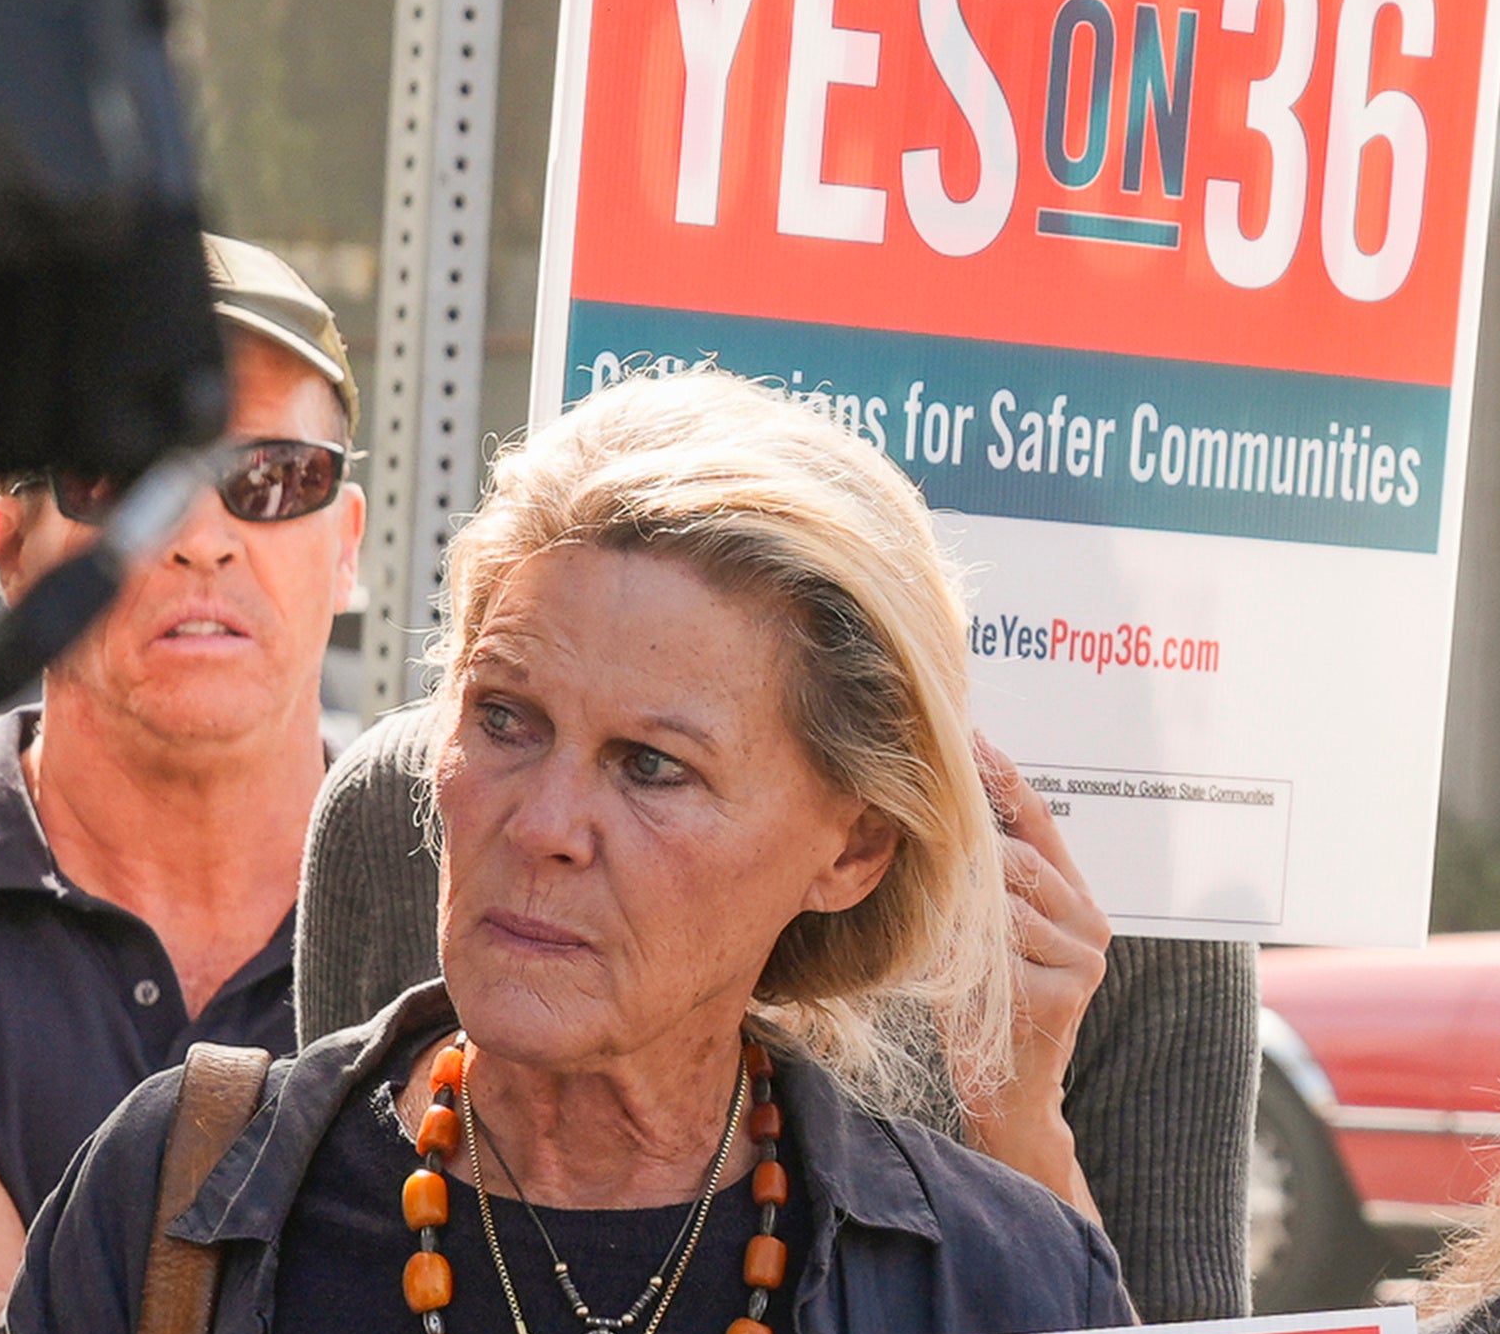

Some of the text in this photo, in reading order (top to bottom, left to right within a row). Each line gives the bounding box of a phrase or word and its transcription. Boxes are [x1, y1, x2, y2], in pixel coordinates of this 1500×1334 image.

[903, 380, 974, 466] for
[987, 388, 1116, 479] Safer
[1130, 402, 1422, 508] Communities
[967, 613, 1221, 675] teYesProp36.com
[1138, 780, 1177, 799] Golden
[1179, 782, 1206, 800] State
[1208, 785, 1275, 805] Communities
